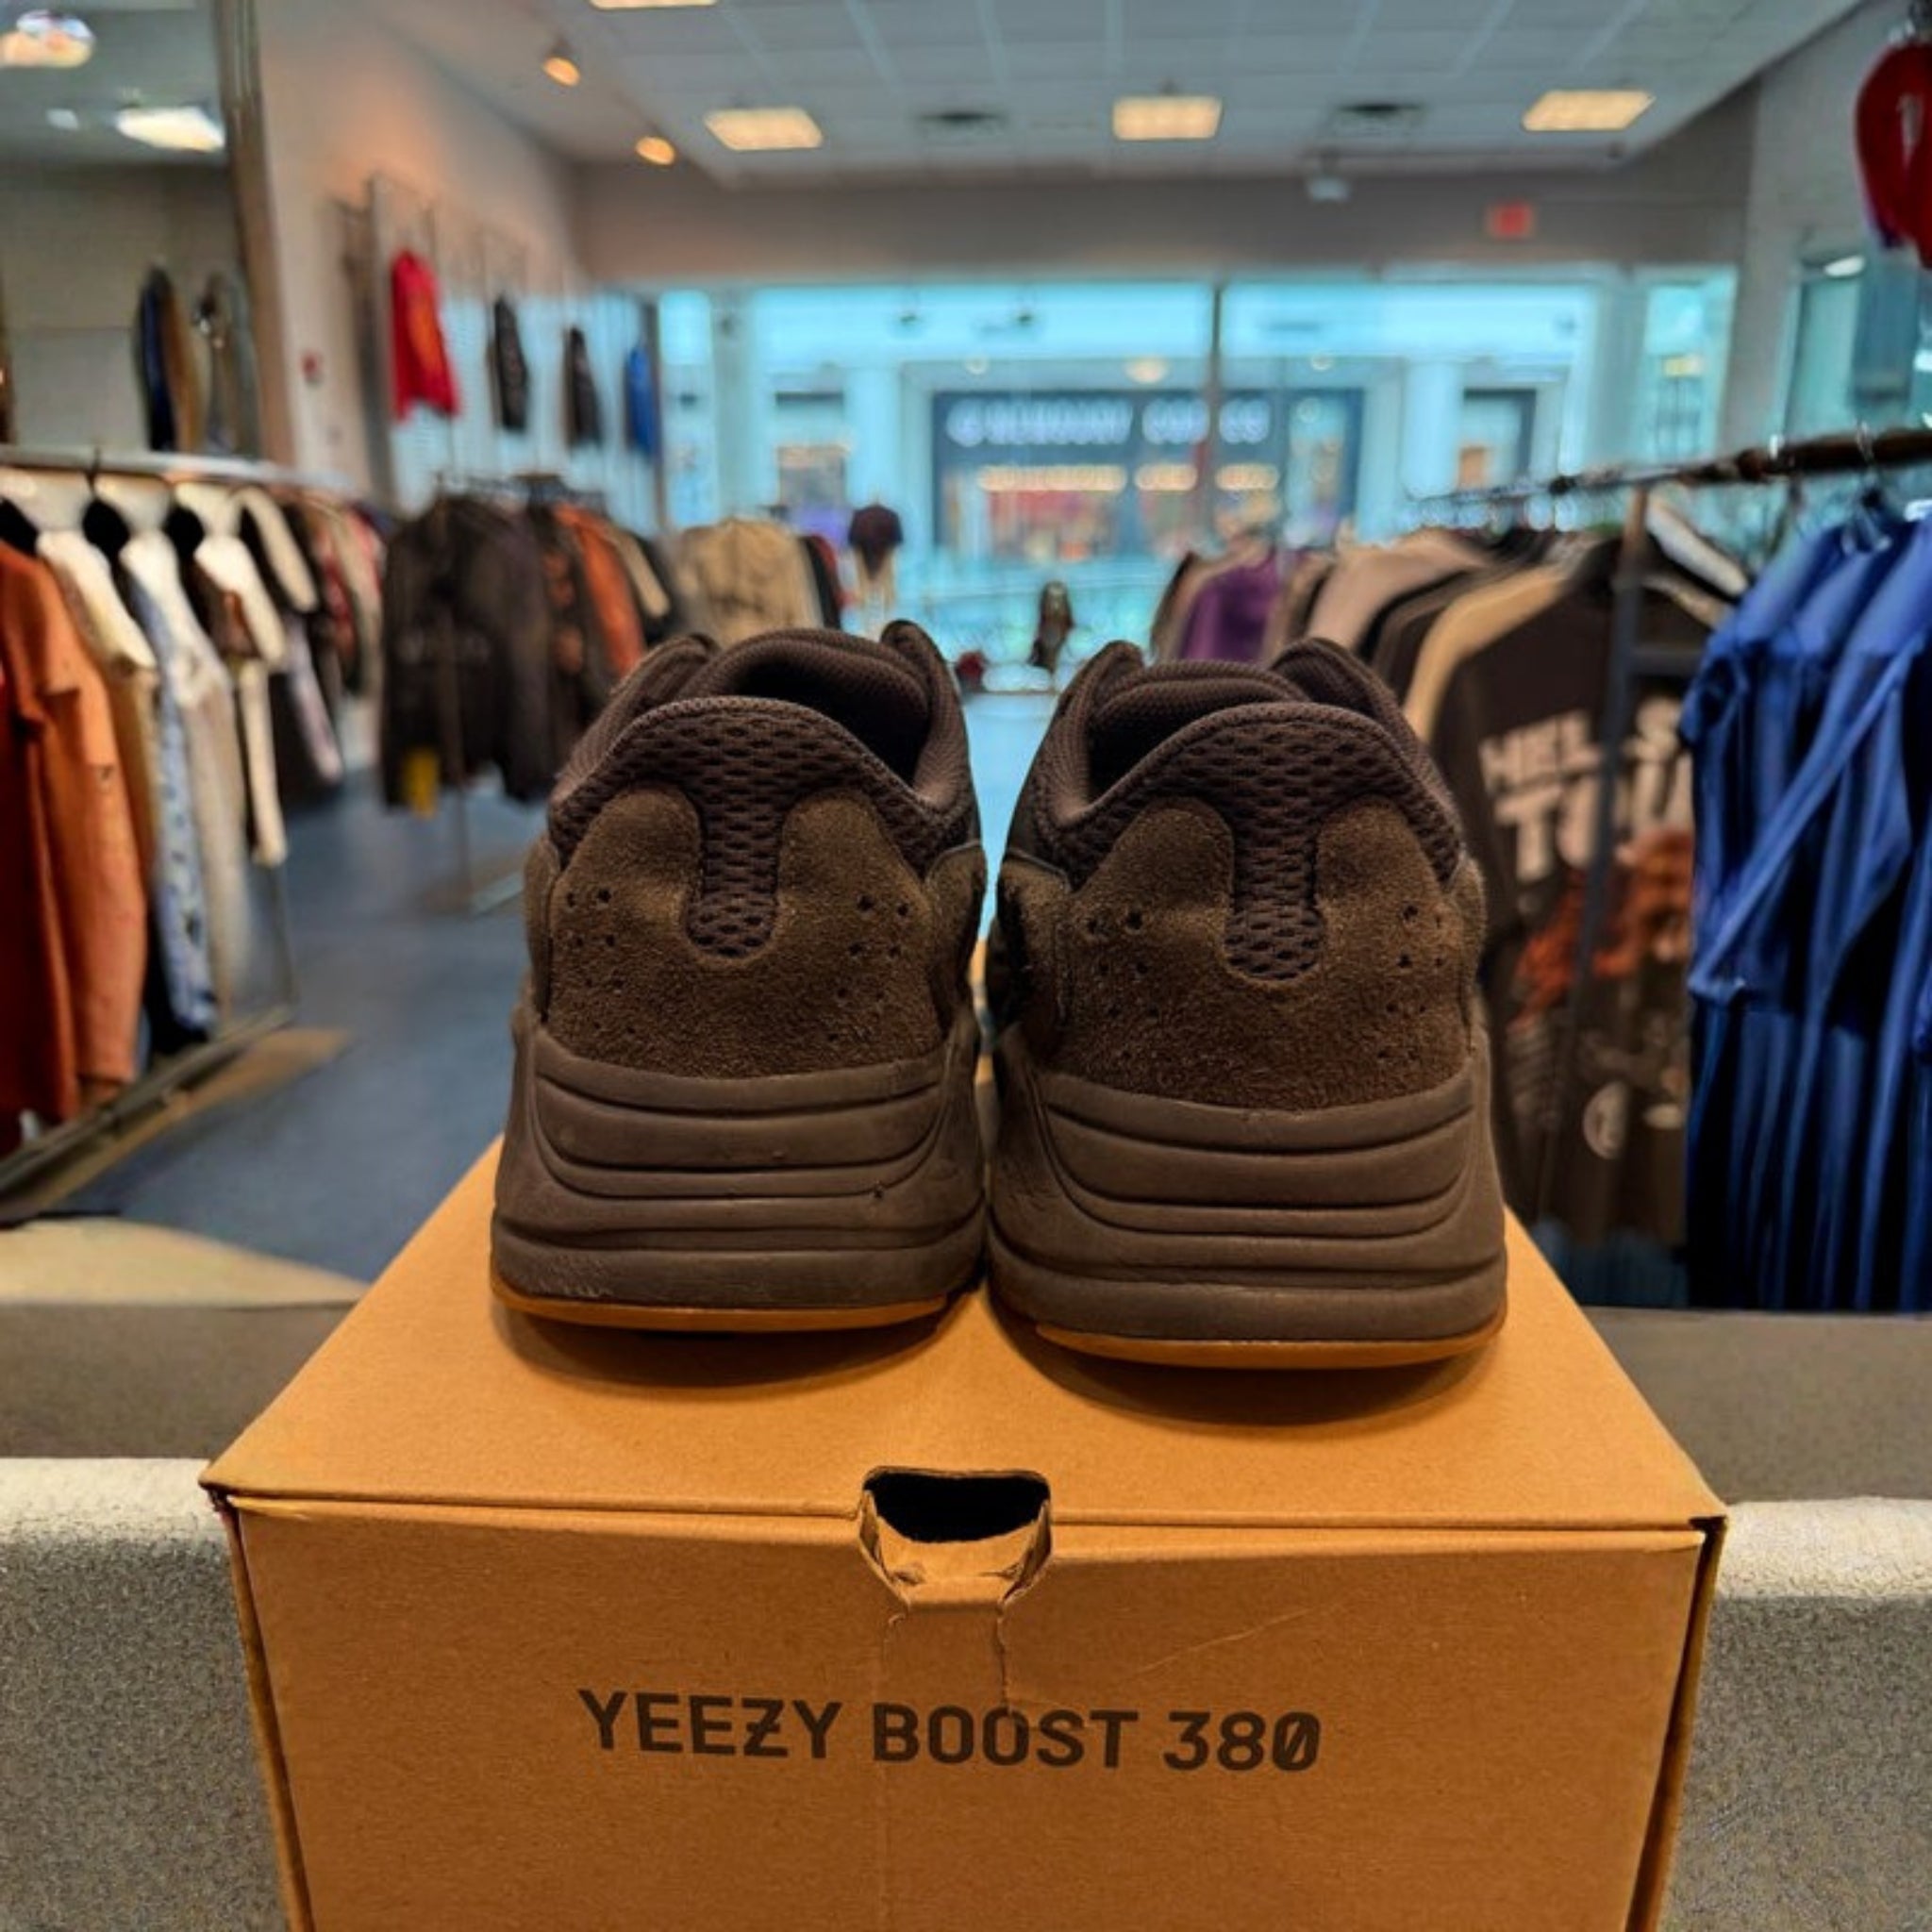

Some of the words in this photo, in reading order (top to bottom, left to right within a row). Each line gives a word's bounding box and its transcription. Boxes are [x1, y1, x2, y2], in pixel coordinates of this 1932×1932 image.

[577, 1689, 842, 1760] YEEZY
[872, 1702, 1140, 1770] BOOST
[1162, 1710, 1322, 1773] 380
